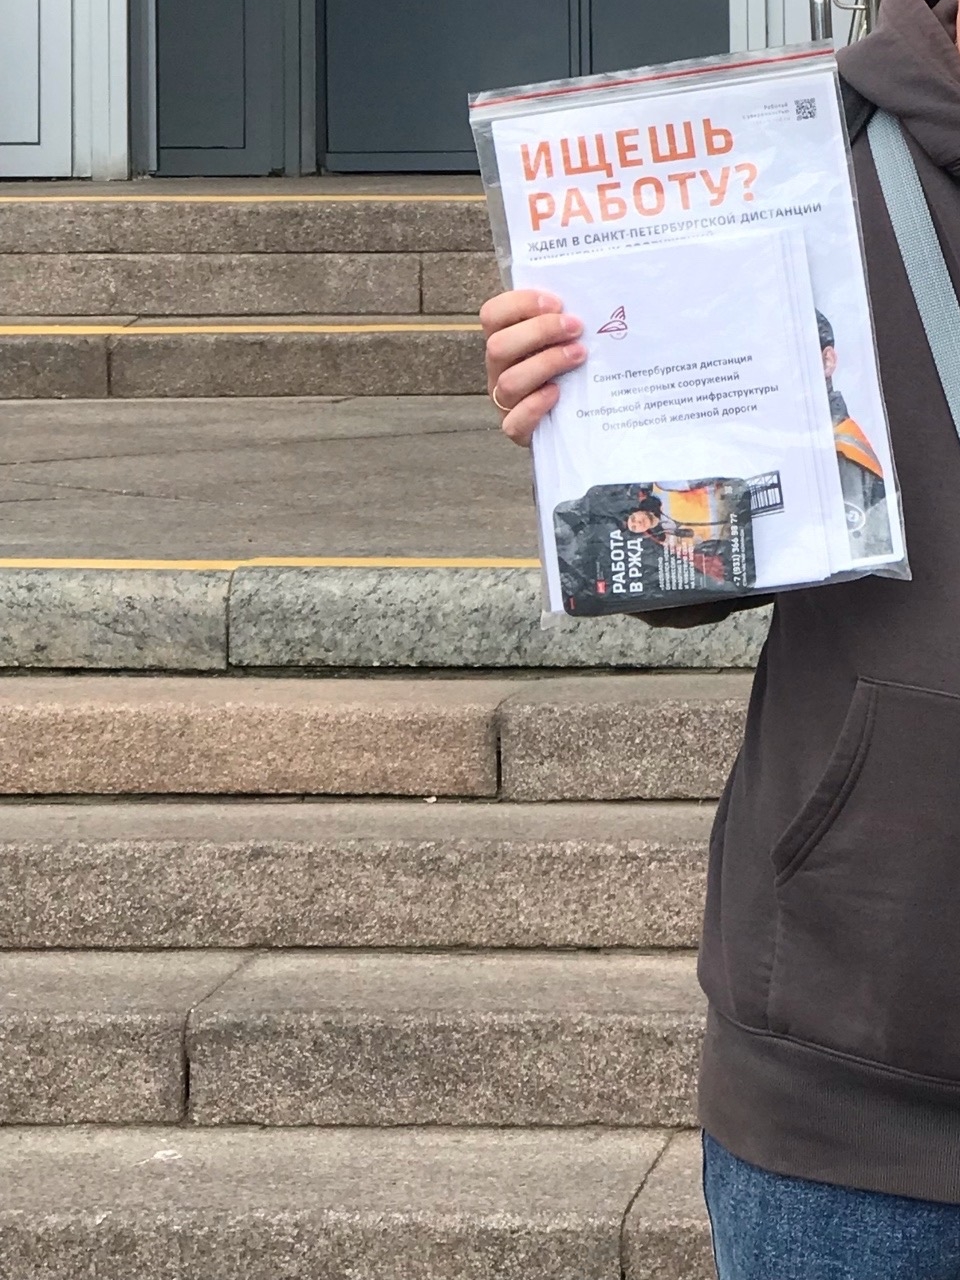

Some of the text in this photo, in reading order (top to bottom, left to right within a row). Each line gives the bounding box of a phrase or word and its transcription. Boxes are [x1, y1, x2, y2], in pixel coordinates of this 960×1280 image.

[520, 117, 734, 182] ИЩЕШЬ
[528, 163, 758, 231] РАБОТУ?
[528, 238, 568, 252] ЖДЕМ
[572, 236, 580, 246] В
[584, 212, 736, 245] САНКТ-ПЕТЕРБУРГСКОЙ
[740, 202, 822, 224] ДИСТАНЦИИ
[593, 354, 753, 383] Санкт-Петербургская дистанция
[611, 372, 740, 397] инженерных сооружений
[576, 384, 779, 419] Октябрьской дирекции инфраструктуры
[602, 404, 757, 432] Октябрьской железной дороги
[610, 529, 627, 594] РАБОТА
[627, 537, 643, 593] В РЖД
